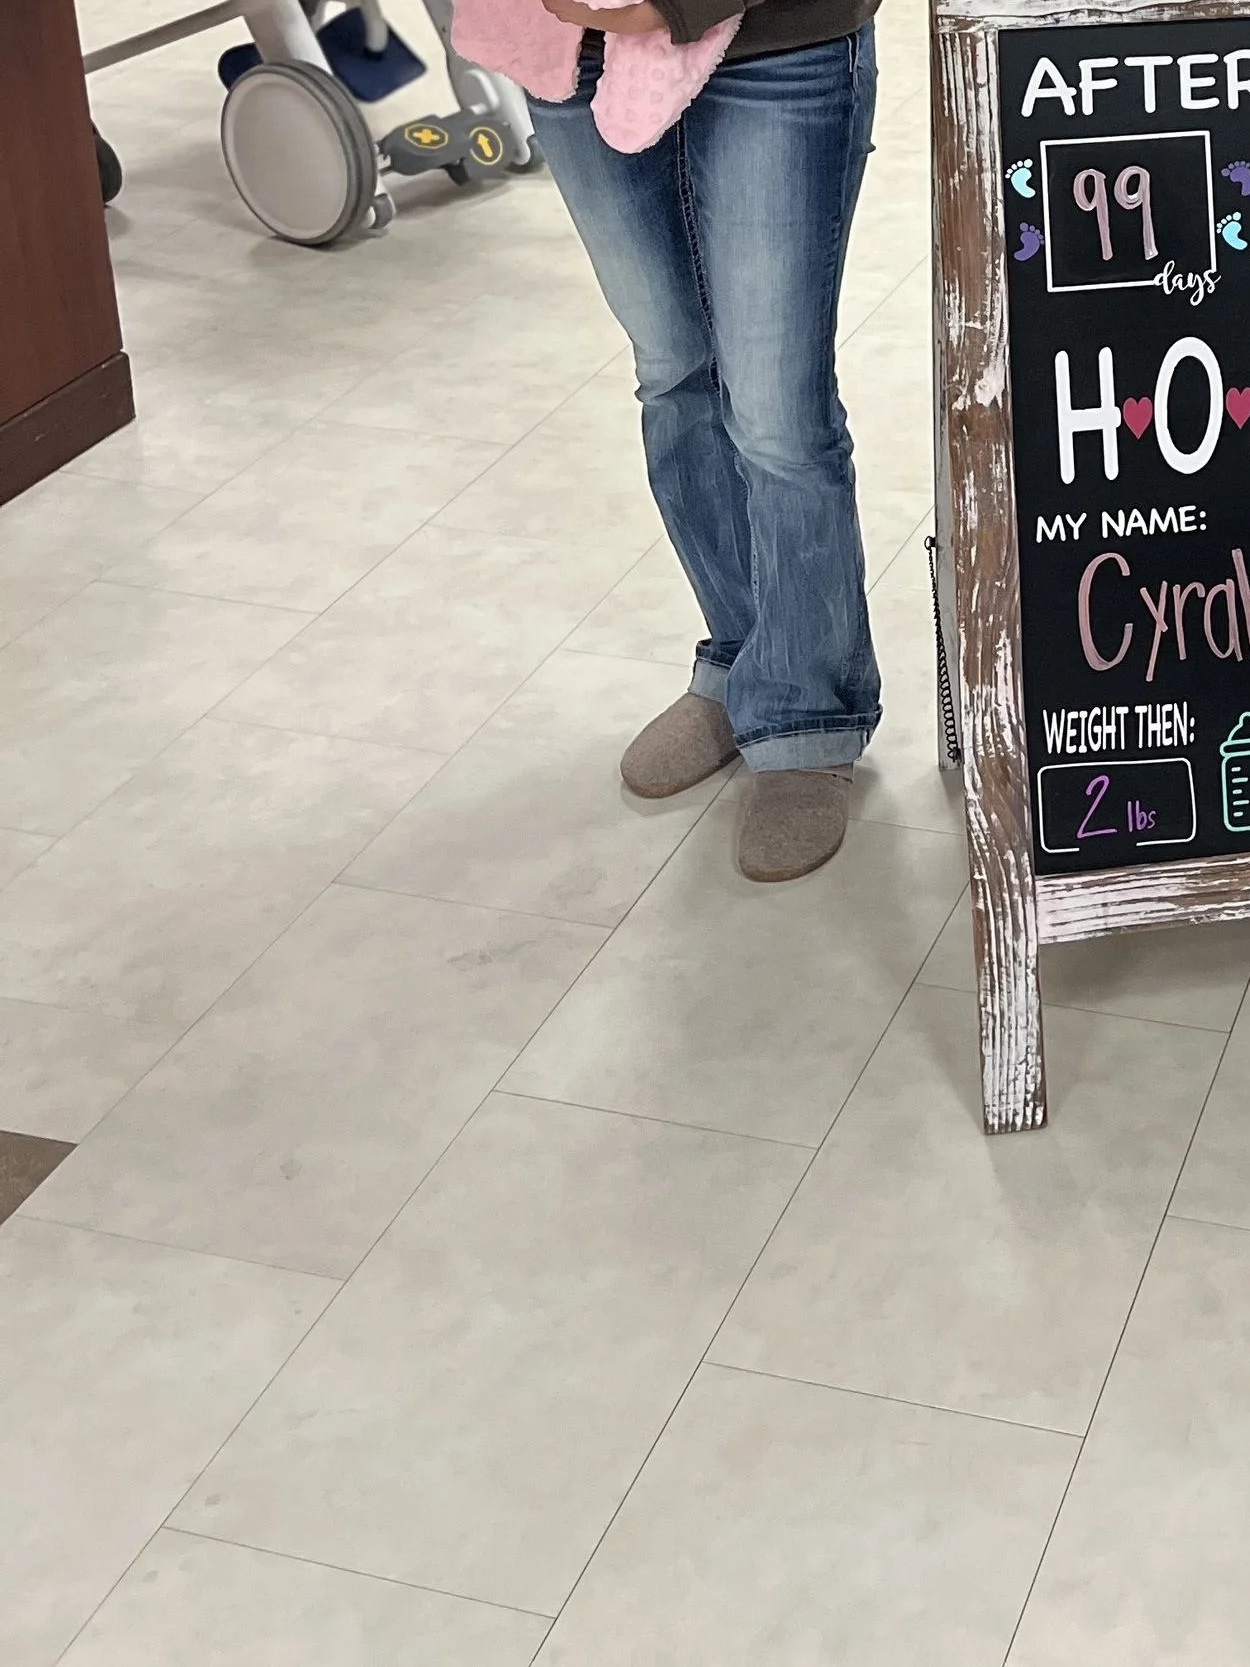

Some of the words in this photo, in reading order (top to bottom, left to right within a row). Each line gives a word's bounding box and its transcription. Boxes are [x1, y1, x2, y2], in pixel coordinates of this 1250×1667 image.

[1072, 165, 1158, 262] 99
[1153, 260, 1221, 306] days
[1035, 511, 1087, 543] MY
[1101, 505, 1207, 537] NAME:
[1043, 706, 1129, 755] WEIGHT
[1134, 701, 1196, 749] THEN:
[1076, 775, 1117, 839] 2
[1127, 799, 1156, 832] lbs
